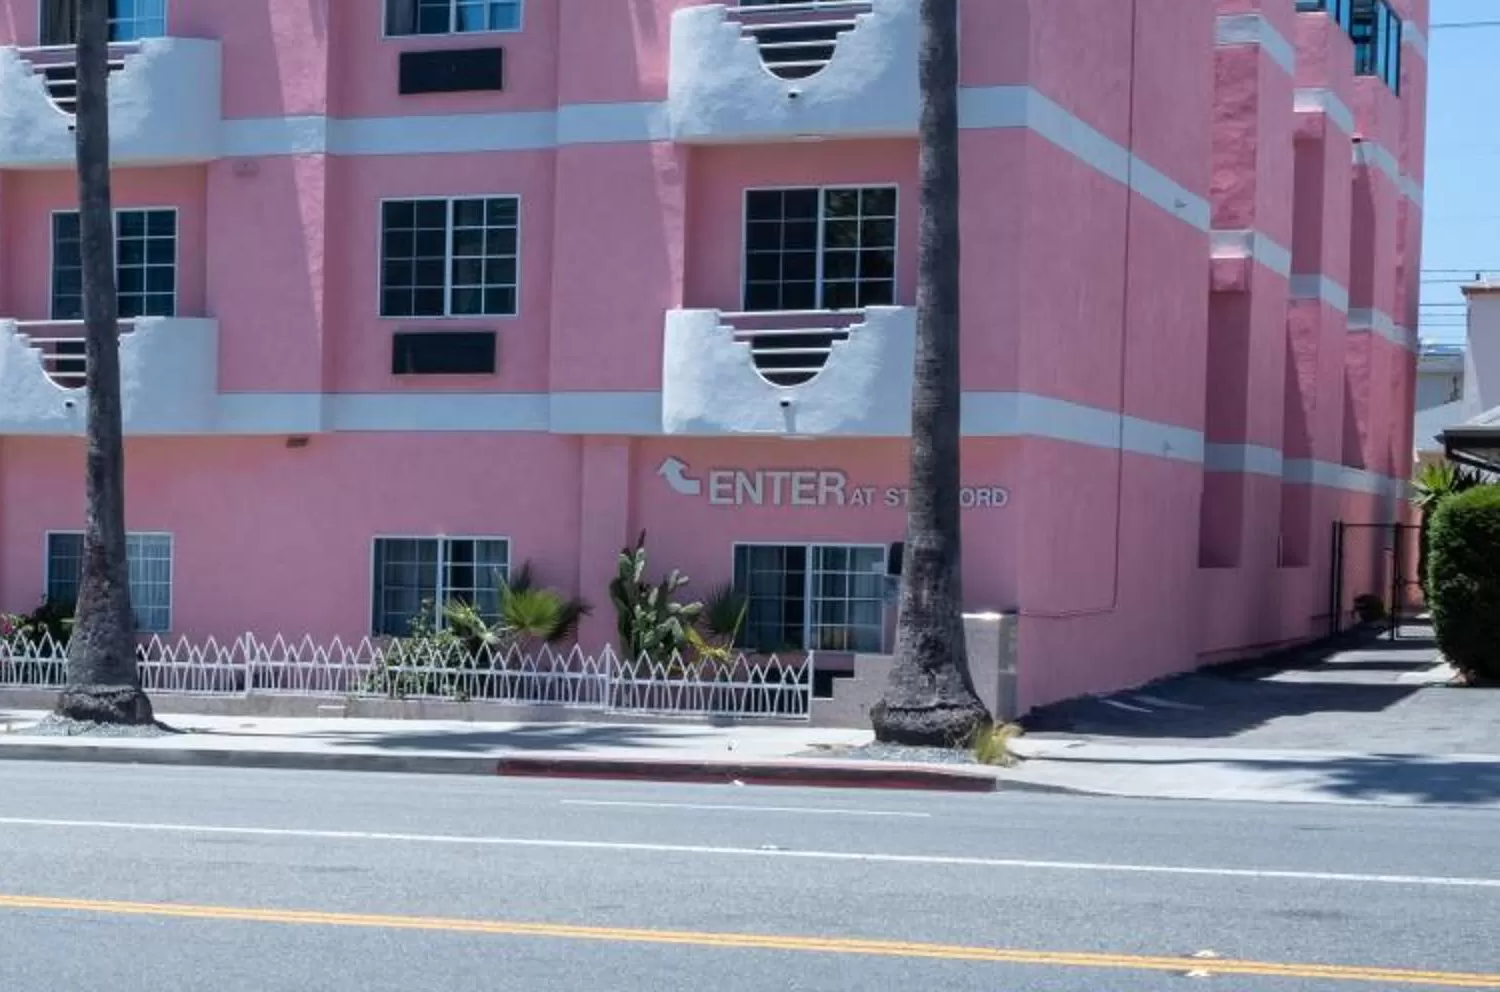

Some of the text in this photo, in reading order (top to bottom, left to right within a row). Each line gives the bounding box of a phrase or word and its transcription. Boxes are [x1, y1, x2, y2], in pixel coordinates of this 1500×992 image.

[708, 470, 1008, 508] ENTER AT STORD
